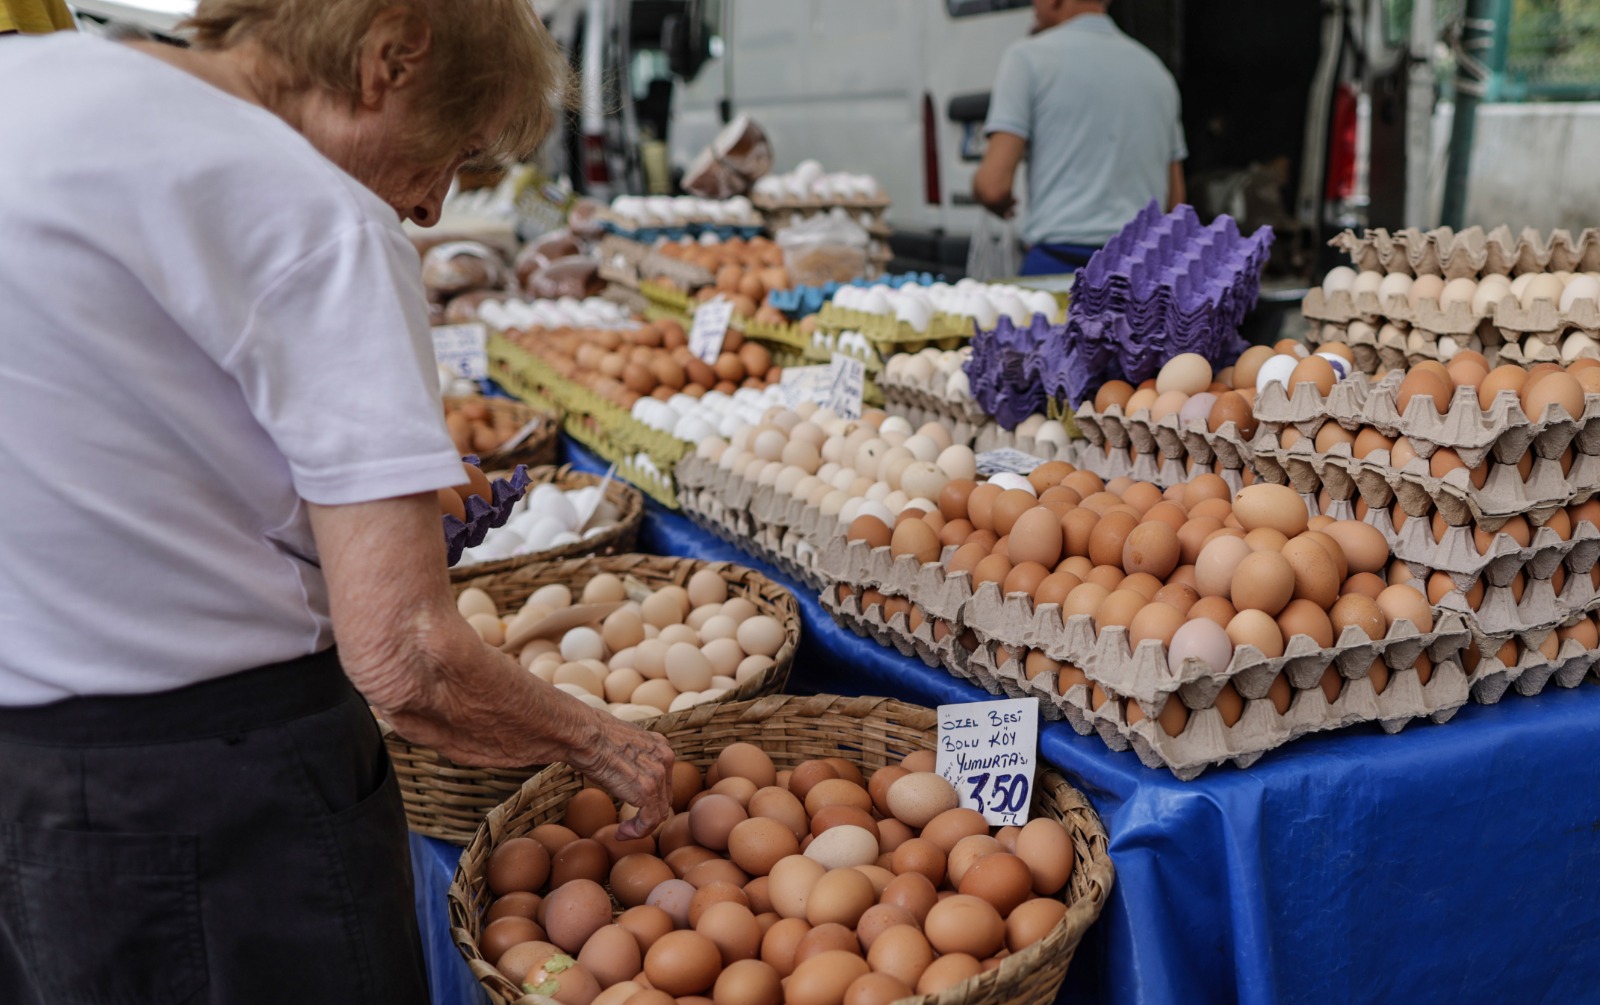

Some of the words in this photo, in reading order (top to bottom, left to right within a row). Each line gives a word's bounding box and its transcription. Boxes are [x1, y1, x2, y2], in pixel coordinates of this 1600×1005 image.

[941, 714, 979, 731] ÖZEL
[942, 735, 979, 752] BOLU
[988, 726, 1016, 748] KÖY
[967, 772, 1029, 814] 3.50
